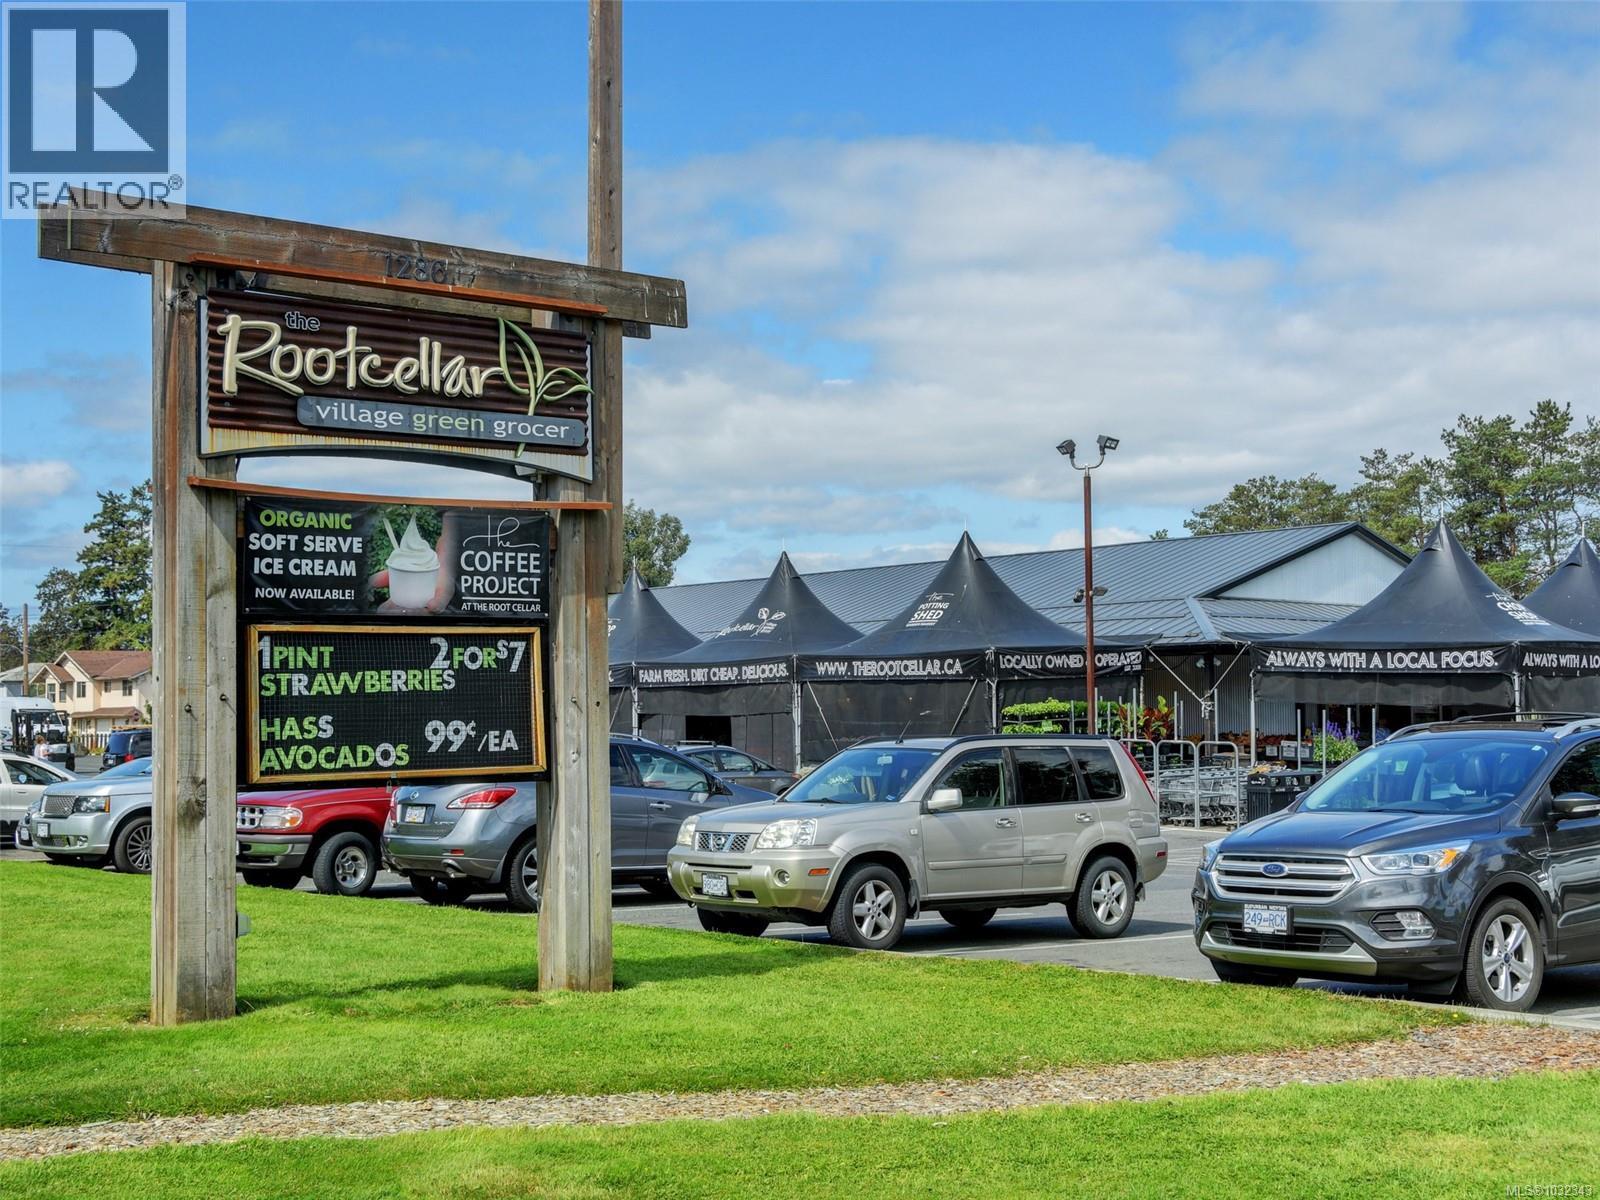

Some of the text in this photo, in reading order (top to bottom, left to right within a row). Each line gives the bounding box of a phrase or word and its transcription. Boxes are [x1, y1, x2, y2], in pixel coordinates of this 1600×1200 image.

[285, 312, 320, 331] the
[217, 314, 504, 398] Rootcellar
[316, 405, 569, 438] village green grocer
[260, 509, 352, 529] ORGANIC
[248, 533, 363, 553] SOFT SERVE
[253, 557, 357, 576] ICE CREAM
[460, 550, 540, 573] COFFEE
[255, 587, 355, 600] NOW AVAILABLE!
[461, 575, 541, 595] PROJECT
[461, 602, 541, 612] AT THE ROOT CELLAR
[911, 610, 944, 621] SHED
[1000, 655, 1043, 668] LOCALLY
[1045, 655, 1083, 668] OWNED
[1266, 651, 1498, 668] ALWAYS WITH A LOCAL FOCUS.
[1522, 652, 1558, 668] ALWAYS
[1559, 654, 1580, 668] WITH
[1581, 655, 1588, 668] A
[261, 670, 456, 698] STRAWBERRIES
[639, 669, 662, 683] FARM
[691, 668, 709, 682] DIRT
[261, 715, 334, 741] HASS
[261, 744, 410, 771] AVOCADOS
